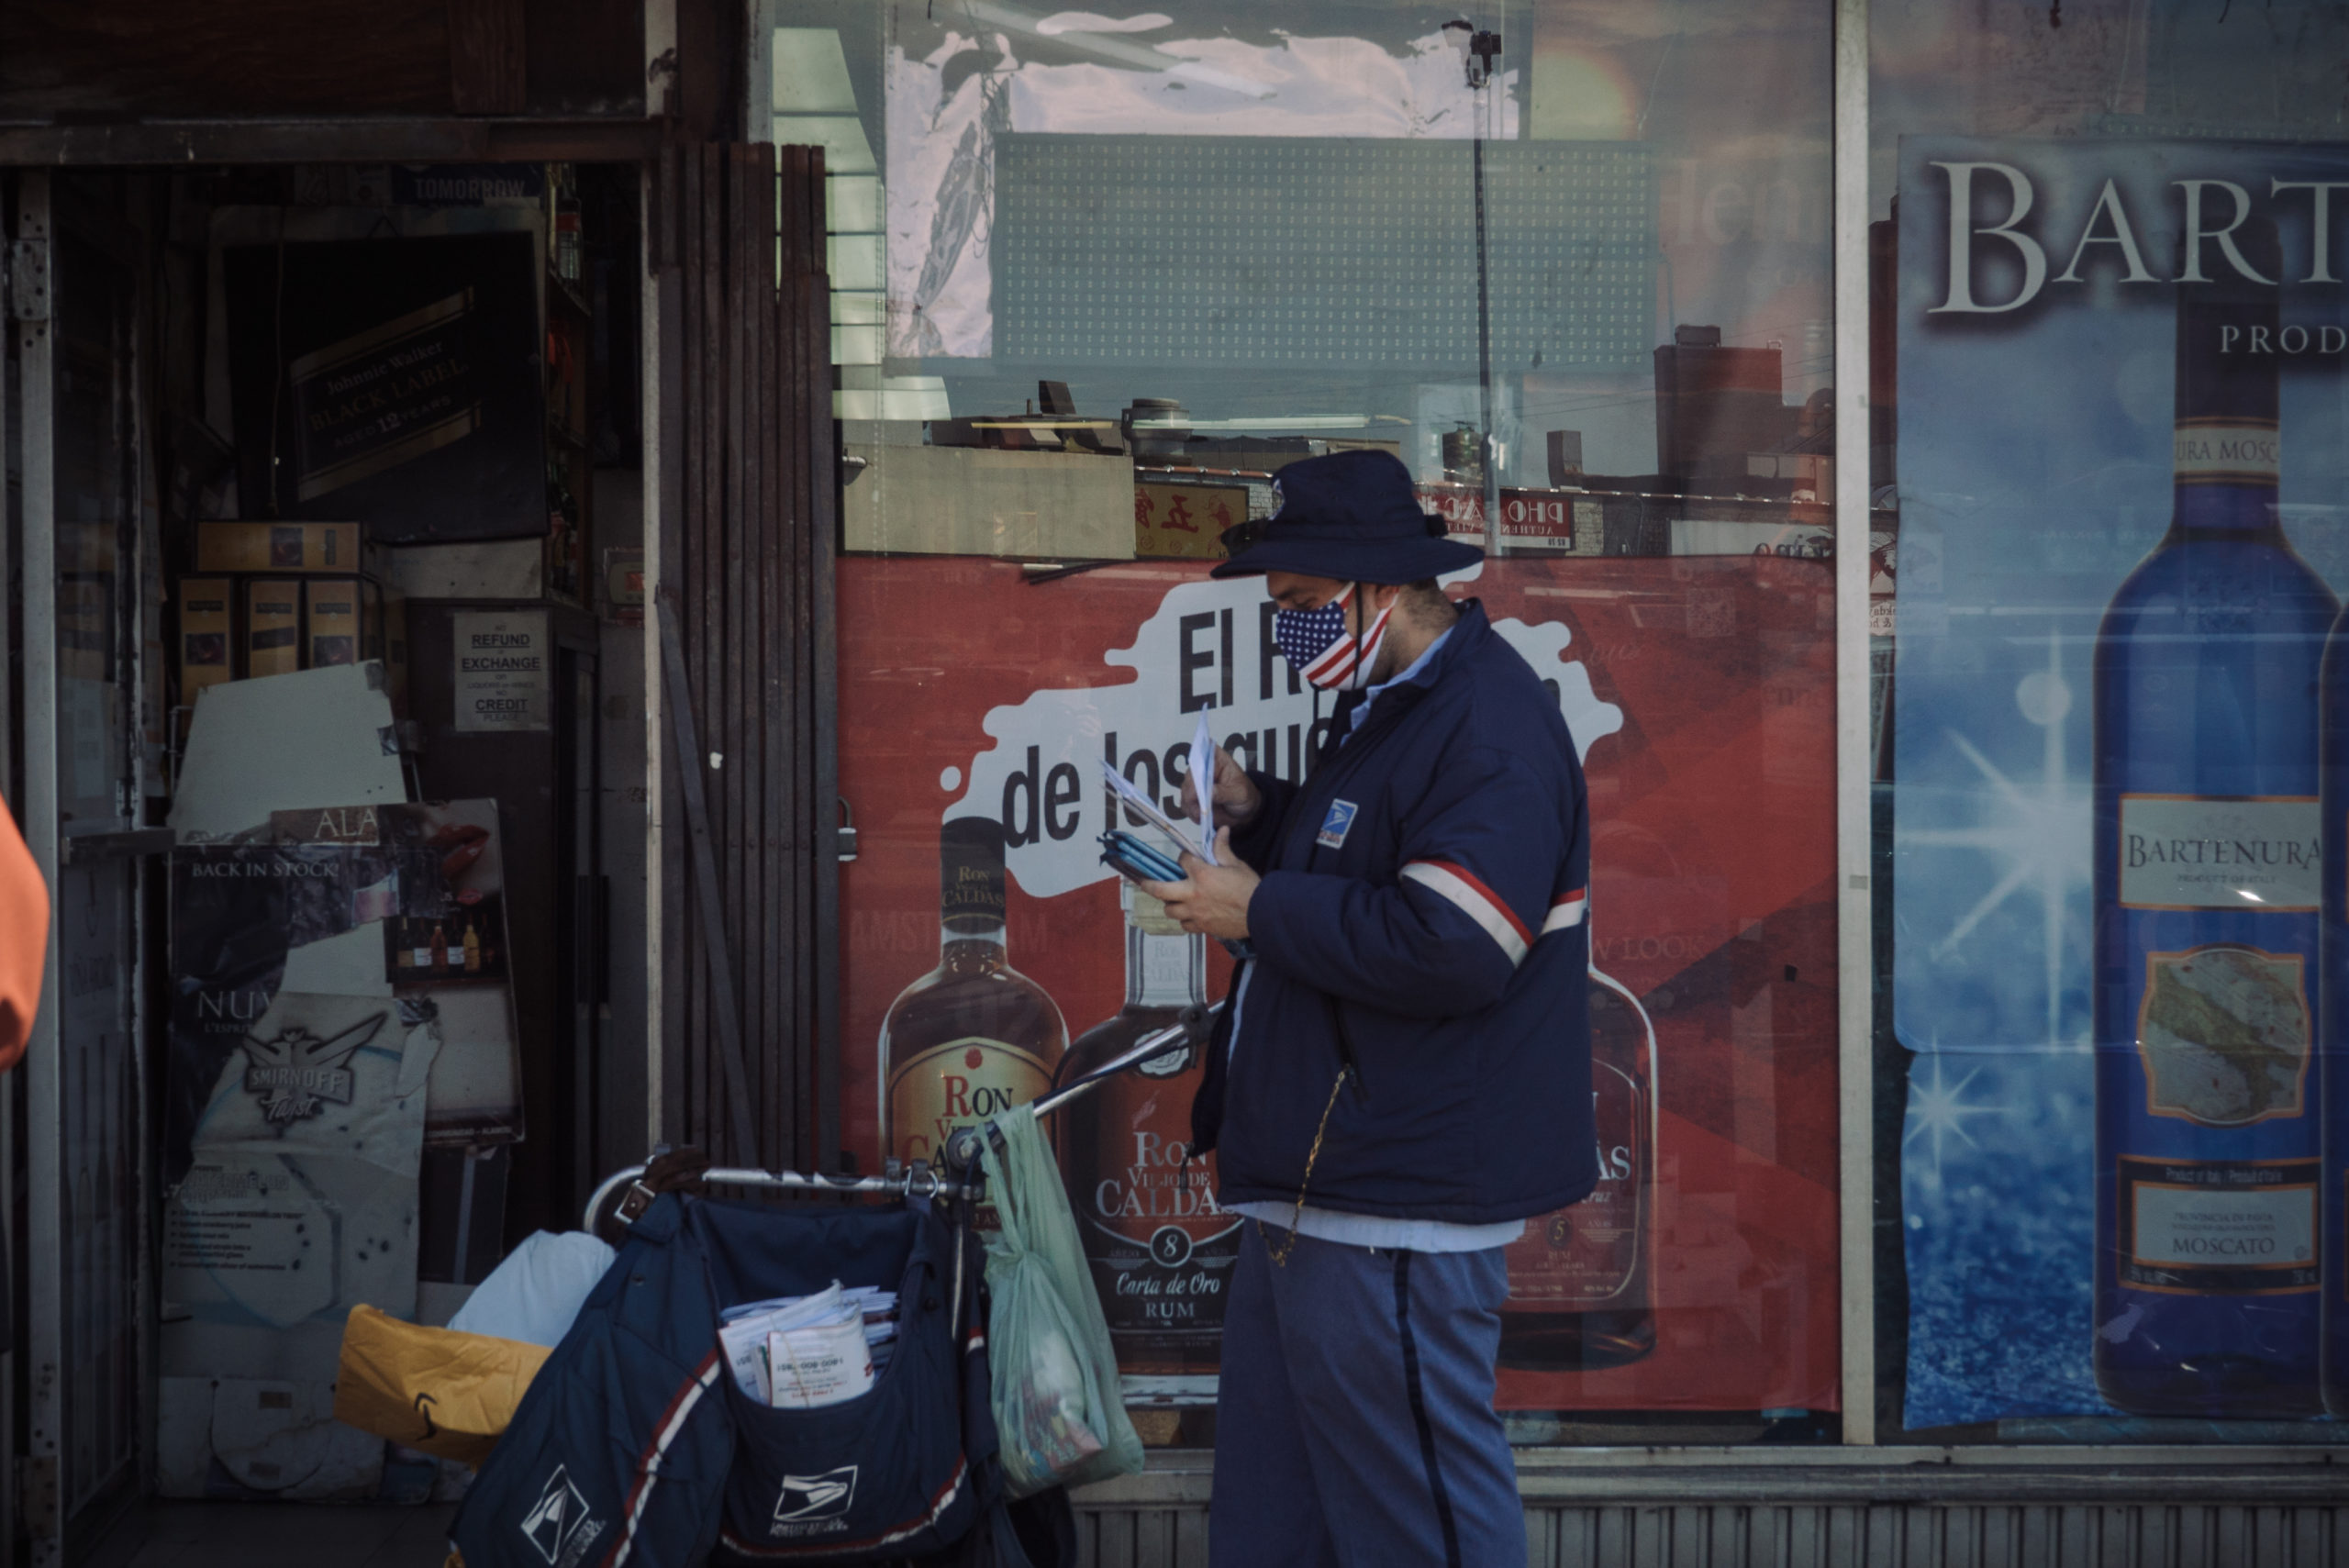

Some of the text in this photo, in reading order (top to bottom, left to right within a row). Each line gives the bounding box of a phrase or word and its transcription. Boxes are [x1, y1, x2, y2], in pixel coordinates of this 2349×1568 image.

[326, 340, 445, 395] Johnnie Walker
[307, 388, 387, 432] BLACK
[377, 412, 402, 433] 12
[472, 634, 530, 646] REFUND
[462, 656, 540, 670] EXCHANGE
[1180, 607, 1234, 715] El
[474, 698, 529, 711] CREDIT
[1003, 745, 1081, 849] de
[192, 862, 241, 878] BACK
[246, 862, 269, 878] IN
[251, 1066, 344, 1093] SMIRNOFF
[1553, 1220, 1564, 1241] 5
[1163, 1233, 1180, 1258] 8
[2172, 1238, 2277, 1255] MOSCATO
[1164, 1271, 1187, 1296] de
[1189, 1270, 1221, 1296] Oro
[1145, 1301, 1197, 1319] RUM
